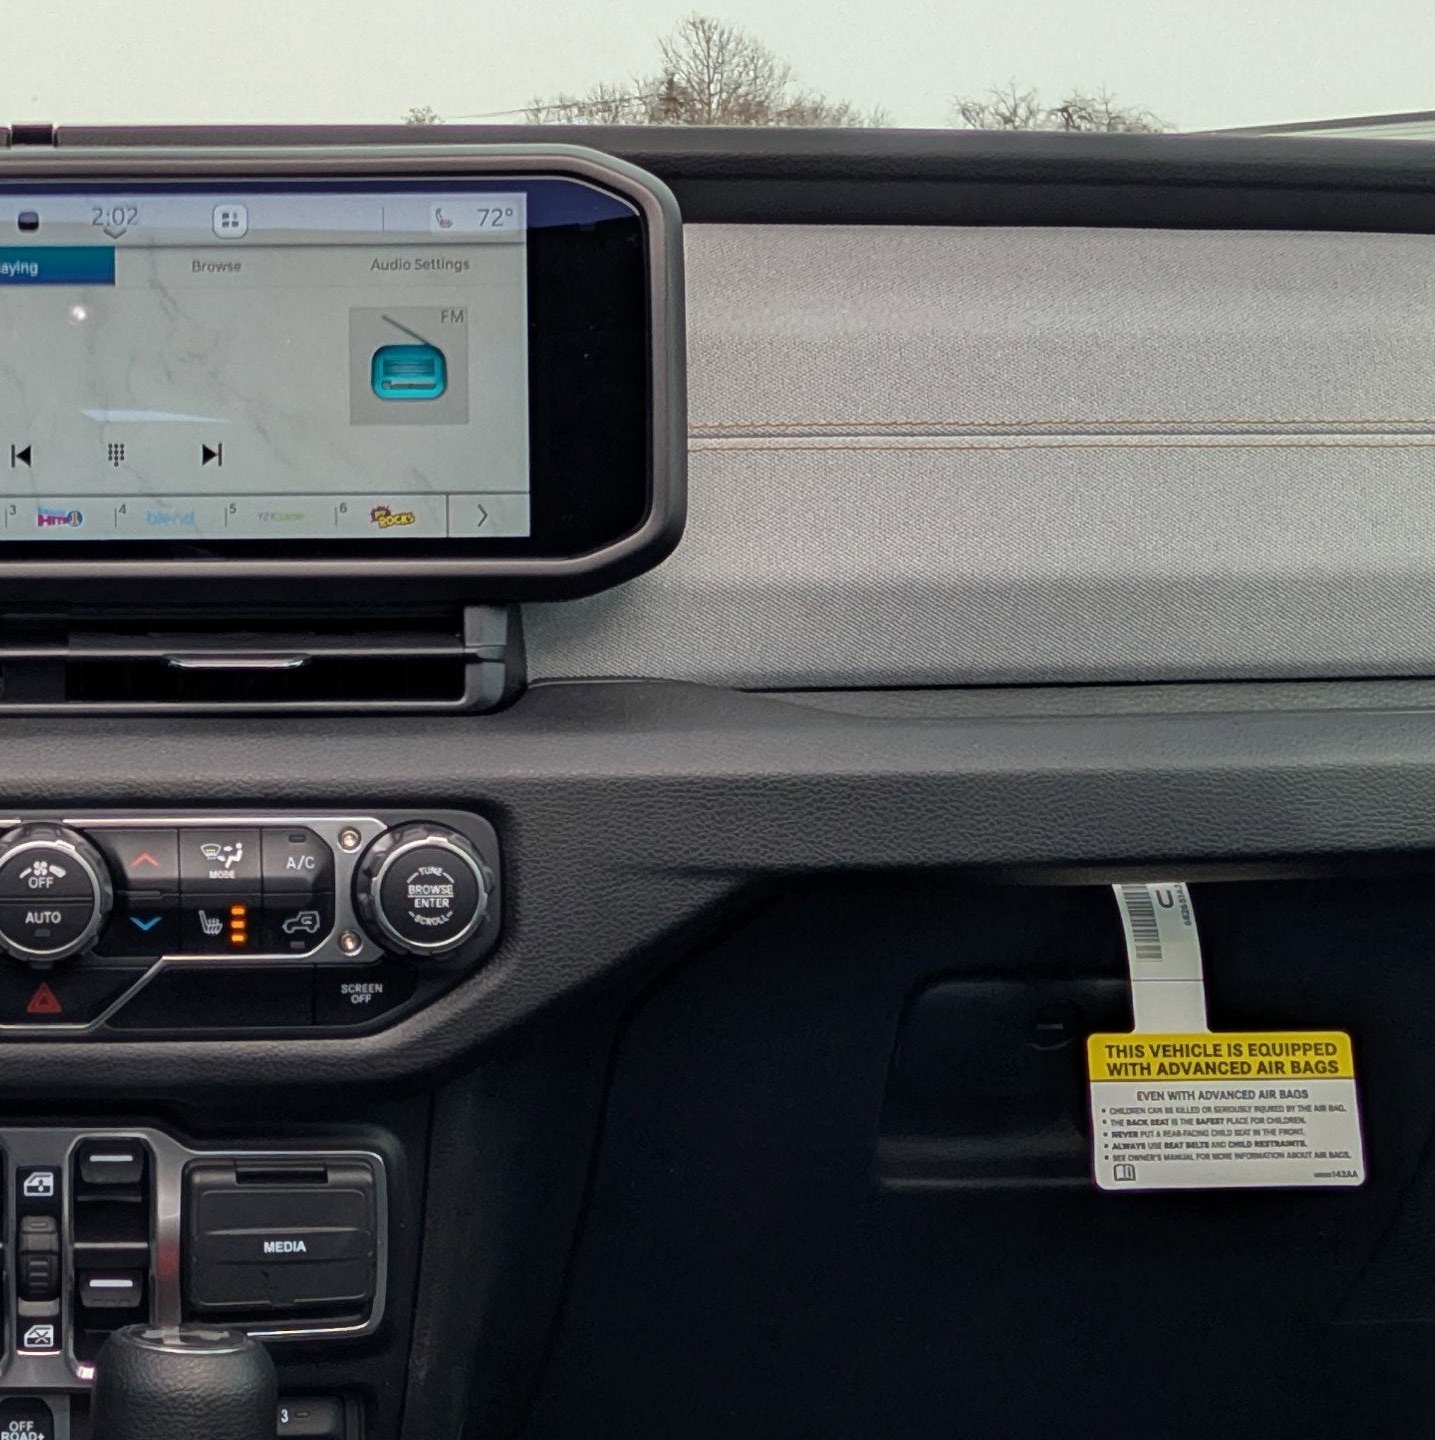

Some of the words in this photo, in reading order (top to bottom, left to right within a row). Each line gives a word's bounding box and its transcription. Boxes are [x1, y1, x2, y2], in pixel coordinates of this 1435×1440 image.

[92, 207, 138, 227] 2:02
[477, 208, 514, 228] 72°
[191, 260, 242, 272] Browse
[371, 258, 412, 272] Audio
[414, 258, 470, 274] Settings
[440, 310, 465, 323] FM
[286, 855, 316, 871] A/C
[209, 870, 235, 880] MODE
[28, 876, 54, 889] OFF
[408, 884, 453, 895] BROWSE
[414, 898, 450, 908] ENTER
[25, 911, 62, 924] AUTO
[340, 982, 383, 994] SCREEN
[350, 993, 372, 1004] OFF
[1105, 1043, 1145, 1059] THIS
[1149, 1043, 1223, 1058] VEHICLE
[1227, 1042, 1244, 1057] IS
[1248, 1042, 1338, 1058] EQUIPPED
[1106, 1062, 1152, 1077] WITH
[1156, 1061, 1252, 1076] ADVANCED
[1256, 1060, 1287, 1075] AIR
[1290, 1059, 1340, 1075] BAGS
[1136, 1091, 1165, 1101] EVEN
[1167, 1090, 1195, 1101] WITH
[1198, 1090, 1256, 1101] ADVANCED
[1258, 1089, 1277, 1100] AIR
[1279, 1089, 1309, 1100] BAGS
[263, 1240, 307, 1254] MEDIA
[280, 1408, 289, 1423] 3
[8, 1421, 34, 1432] OFF
